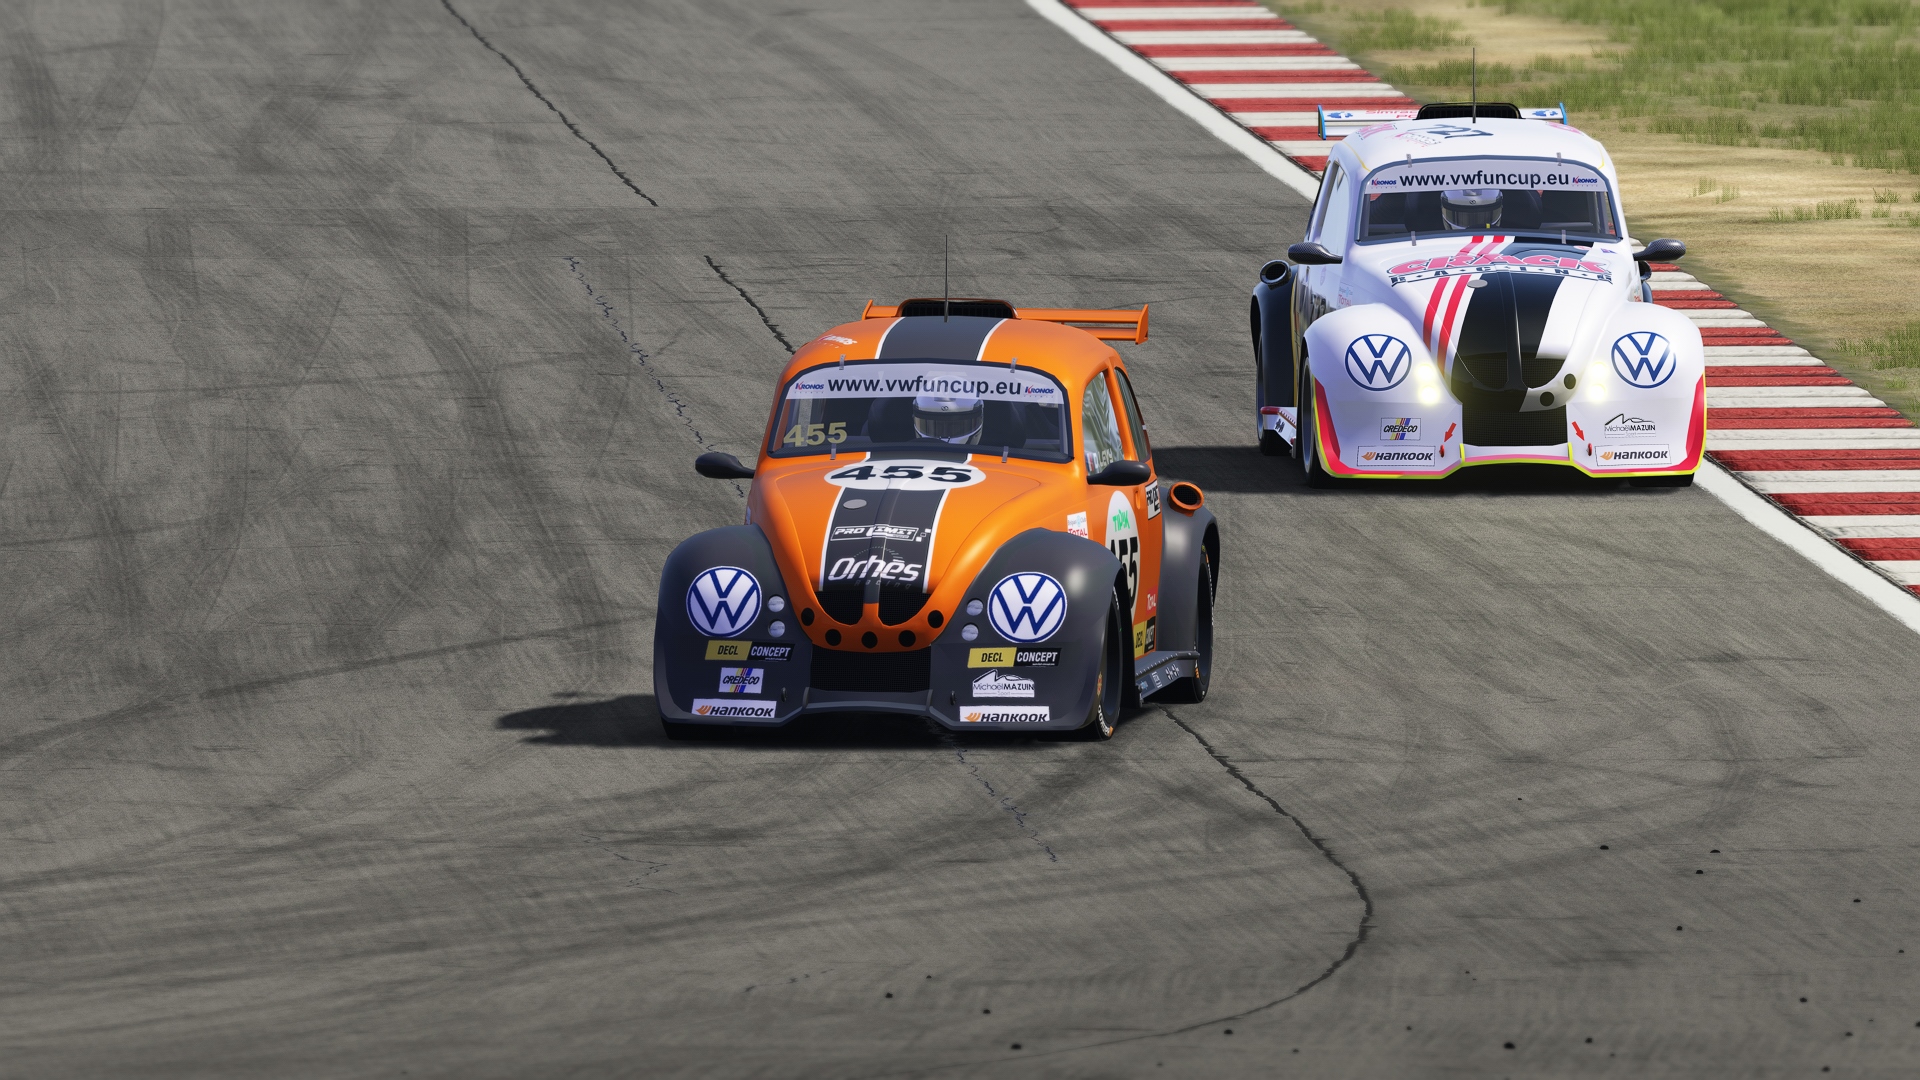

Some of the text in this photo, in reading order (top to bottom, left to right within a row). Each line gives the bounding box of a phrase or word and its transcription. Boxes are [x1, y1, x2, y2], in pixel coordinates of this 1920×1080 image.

[1371, 178, 1397, 186] KRONOS
[1399, 170, 1569, 188] www.vwfuncup.eu
[1572, 176, 1598, 184] KRONOS
[1388, 254, 1609, 275] CRACK
[1346, 335, 1410, 388] VW
[1612, 331, 1673, 385] VW
[795, 381, 824, 391] KRONOS
[828, 376, 1022, 398] www.vwfuncup.eu
[1025, 385, 1055, 394] KRONOS
[783, 421, 848, 447] 455
[1383, 425, 1418, 433] CREDECO
[831, 465, 972, 483] 455
[689, 569, 760, 632] VW
[991, 573, 1065, 638] VW
[717, 645, 791, 658] DECL CONCEPT
[981, 651, 1058, 663] DECL CONCEPT
[722, 675, 760, 685] CREDECO
